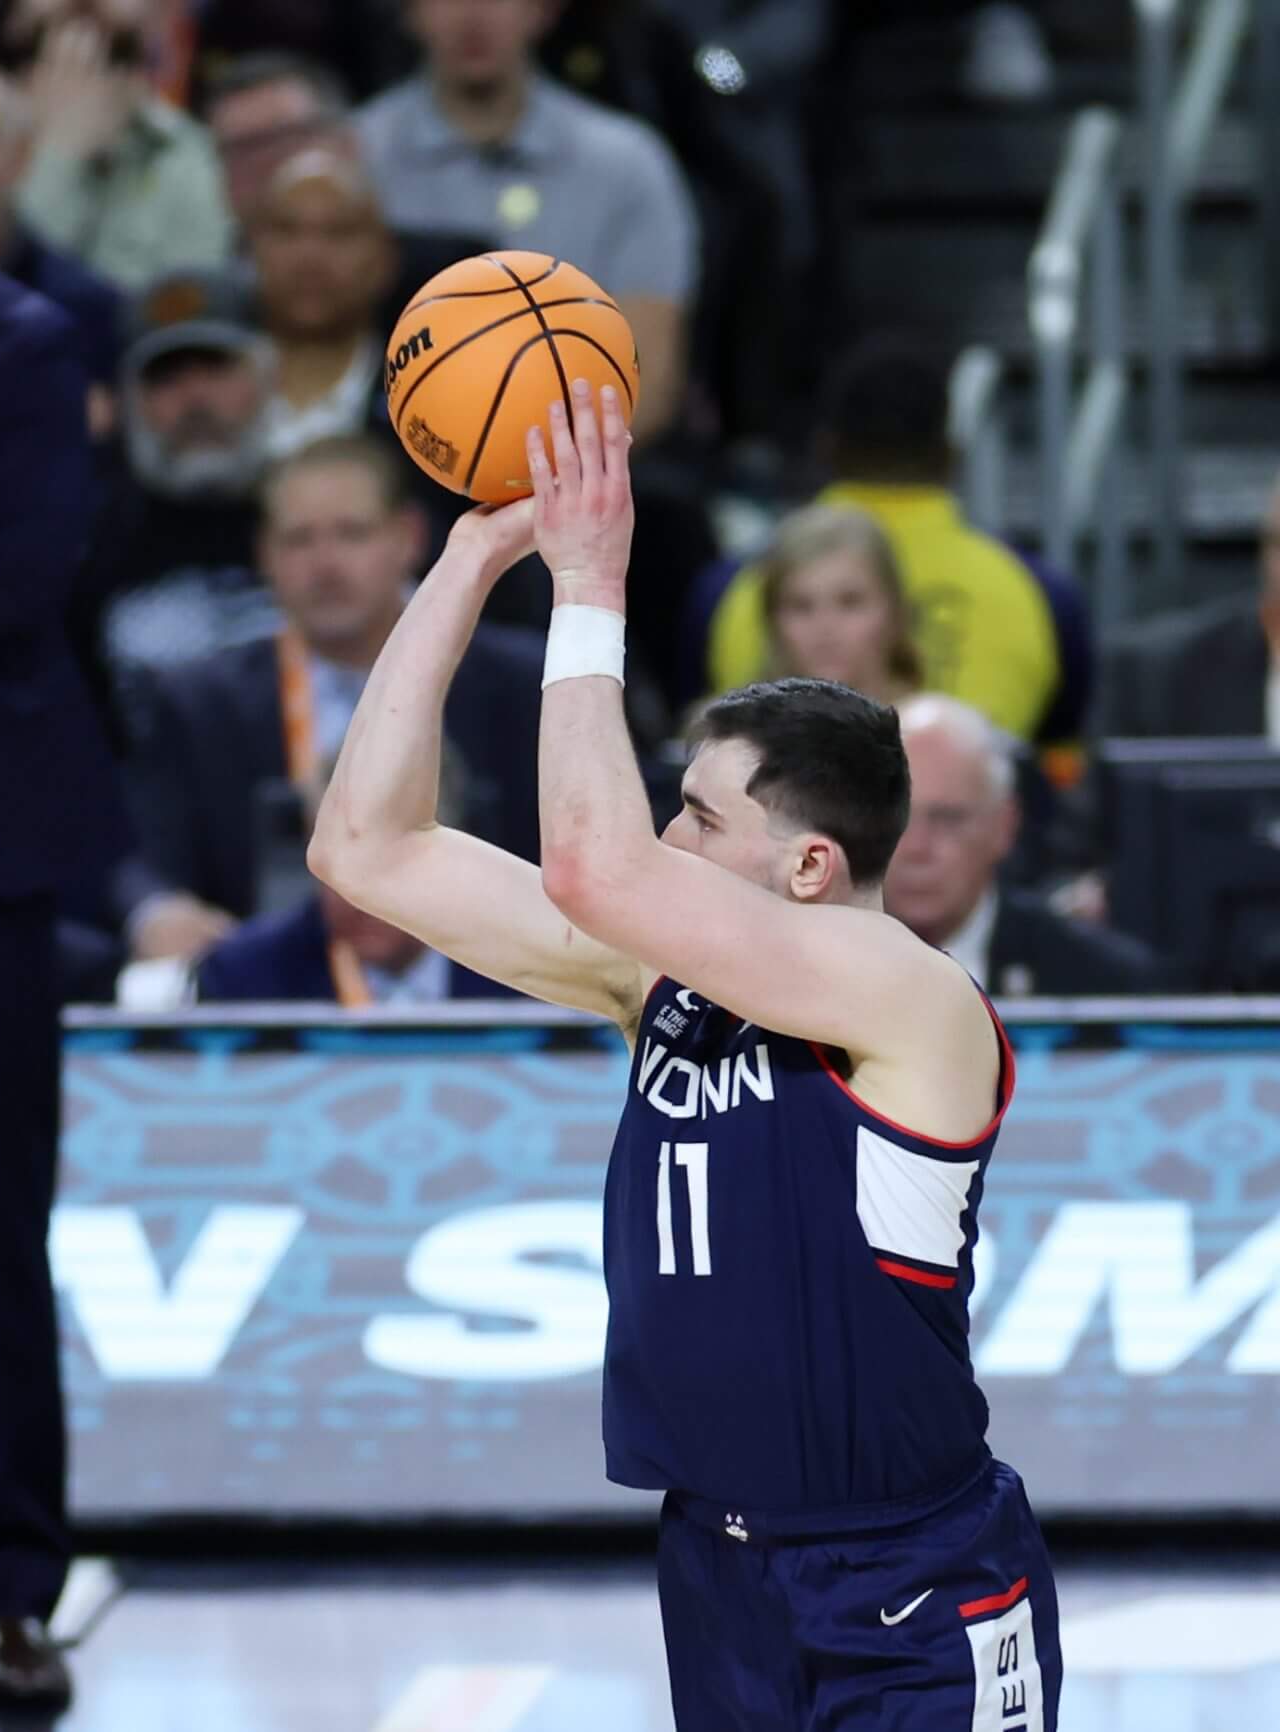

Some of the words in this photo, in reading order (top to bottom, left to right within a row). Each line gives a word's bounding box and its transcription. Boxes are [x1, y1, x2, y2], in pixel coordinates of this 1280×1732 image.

[388, 326, 434, 386] son
[667, 1008, 690, 1029] THE
[656, 1140, 712, 1276] 11
